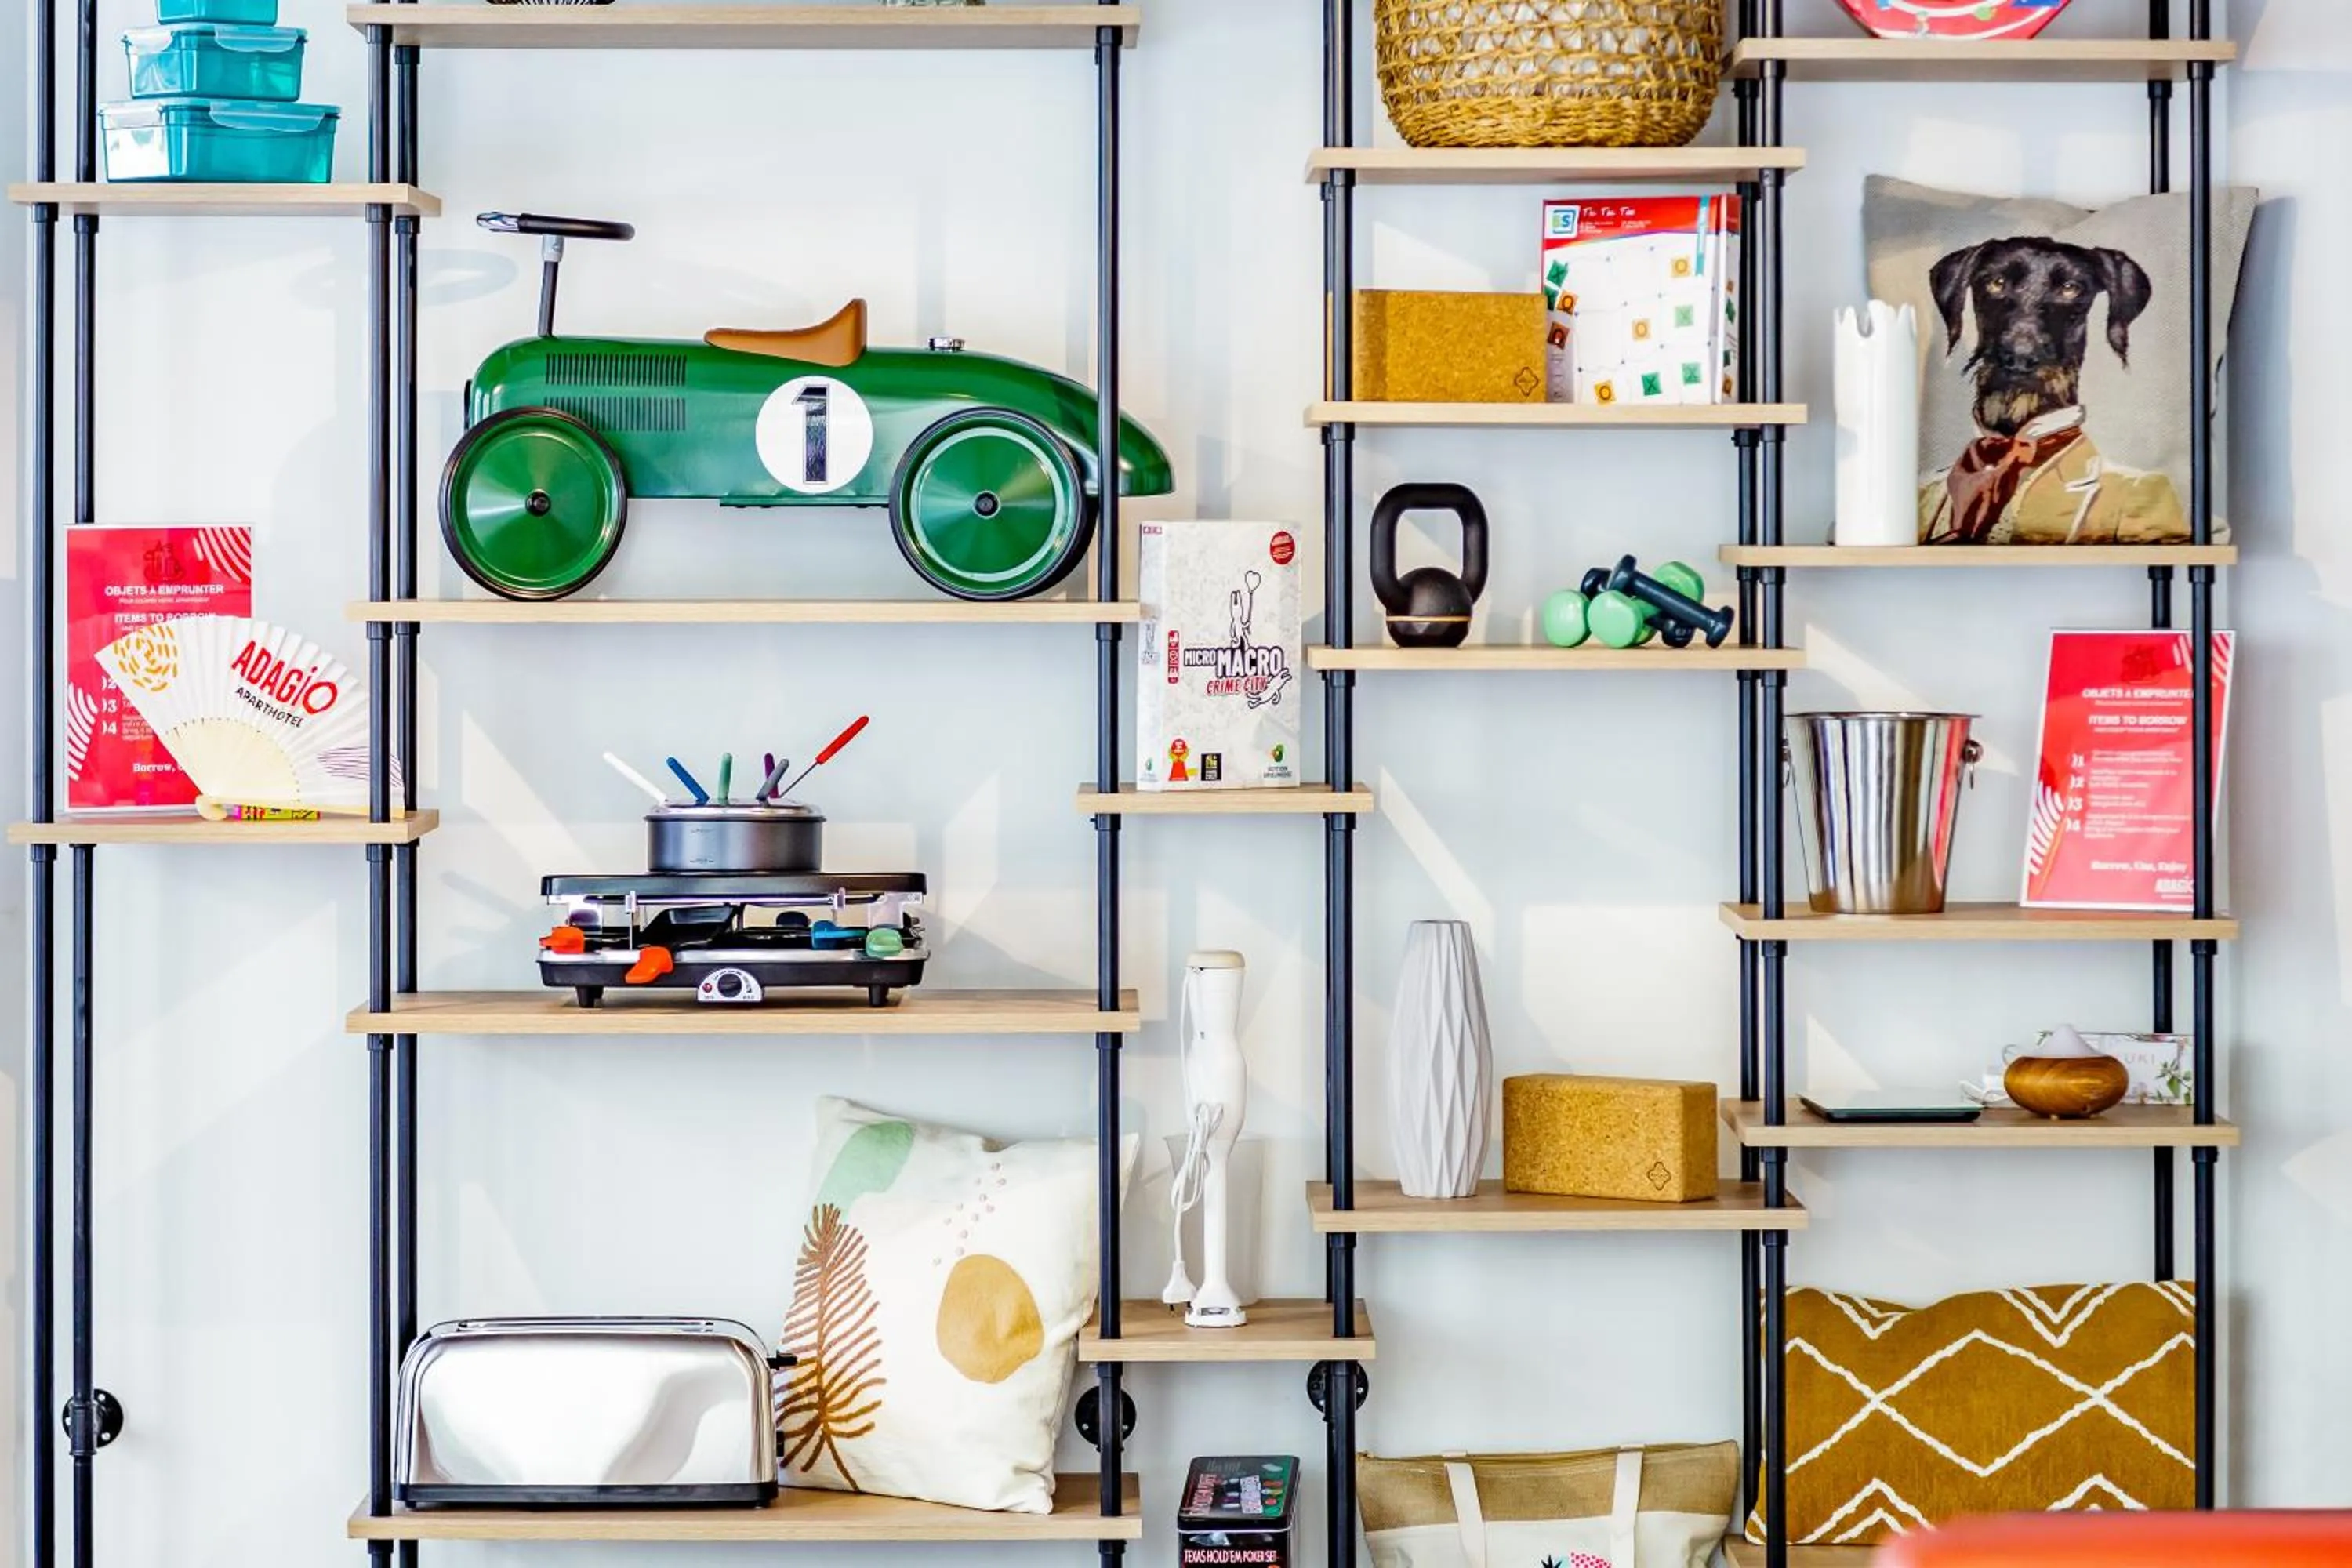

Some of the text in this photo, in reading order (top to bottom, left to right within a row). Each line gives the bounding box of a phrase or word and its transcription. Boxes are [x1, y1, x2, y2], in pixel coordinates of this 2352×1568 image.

[792, 383, 829, 485] 1
[104, 586, 147, 596] OBJETS
[158, 584, 223, 595] EMPRUNTER
[114, 612, 147, 623] ITEMS
[150, 612, 164, 622] TO
[1185, 649, 1216, 666] MICRO
[1217, 647, 1283, 677] MACRO
[1207, 678, 1240, 694] CRIME
[235, 687, 304, 728] APARTHOTEL
[133, 762, 176, 773] Borrow,
[1184, 1549, 1206, 1563] TEXAS
[1243, 1550, 1264, 1563] POKER
